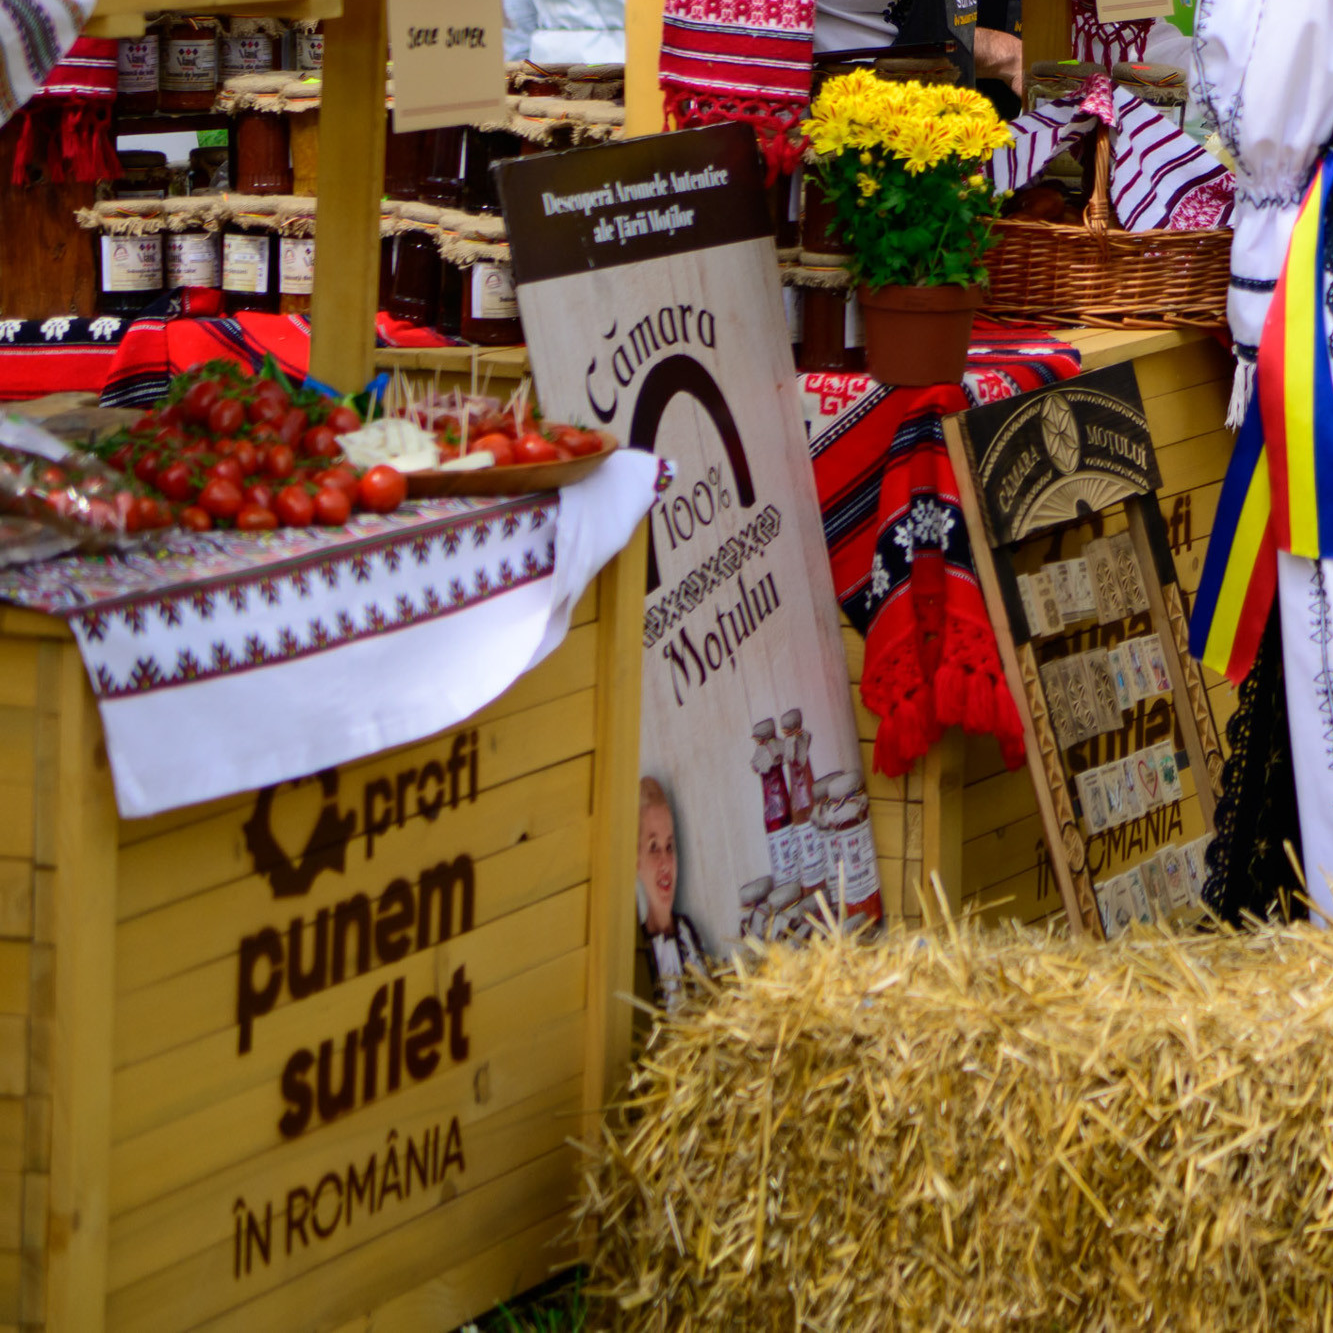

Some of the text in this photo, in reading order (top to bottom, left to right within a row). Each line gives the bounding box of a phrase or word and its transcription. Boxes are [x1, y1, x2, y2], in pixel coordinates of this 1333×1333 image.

[542, 165, 729, 216] Descoperă Aromele Autentice
[593, 218, 615, 243] ale
[586, 303, 717, 424] Cămara
[660, 462, 732, 552] 100%
[663, 572, 782, 707] Moțului
[365, 728, 479, 861] profi
[236, 853, 475, 1057] punem
[278, 963, 472, 1140] suflet
[232, 1116, 466, 1282] ÎN ROMÂNIA
